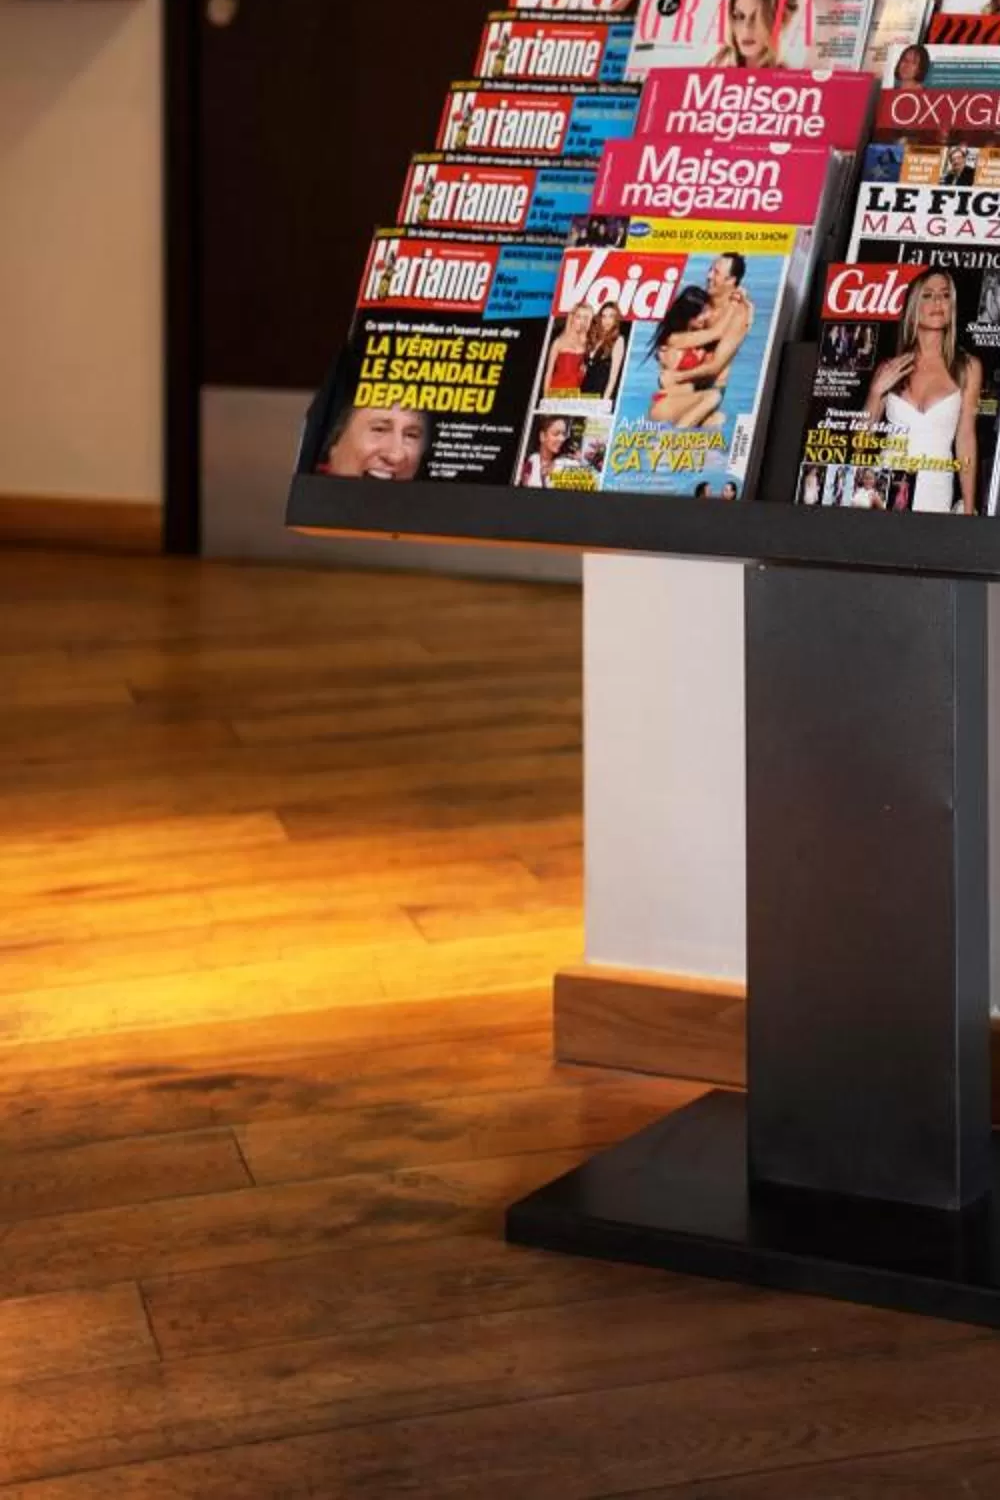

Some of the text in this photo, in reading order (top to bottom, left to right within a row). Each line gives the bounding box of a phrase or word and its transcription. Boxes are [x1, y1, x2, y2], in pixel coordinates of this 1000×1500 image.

[480, 21, 601, 77] Marianne
[682, 73, 823, 113] Maison
[442, 92, 566, 151] Marianne
[665, 109, 825, 142] magazine
[637, 145, 781, 186] Maison
[404, 164, 528, 224] Marianne
[620, 182, 782, 217] magazine
[866, 187, 916, 214] LE
[364, 238, 491, 301] Marianne
[897, 244, 923, 265] La
[559, 248, 678, 318] Voici
[366, 334, 508, 362] LA VÉRITÉ SUR
[360, 358, 503, 386] LE SCANDALE
[354, 382, 496, 414] DEPARDIEU
[614, 431, 656, 449] AVEC
[807, 429, 848, 448] Elles
[849, 418, 870, 431] les
[669, 450, 694, 473] VA
[805, 447, 848, 465] NON
[851, 452, 885, 466] aux
